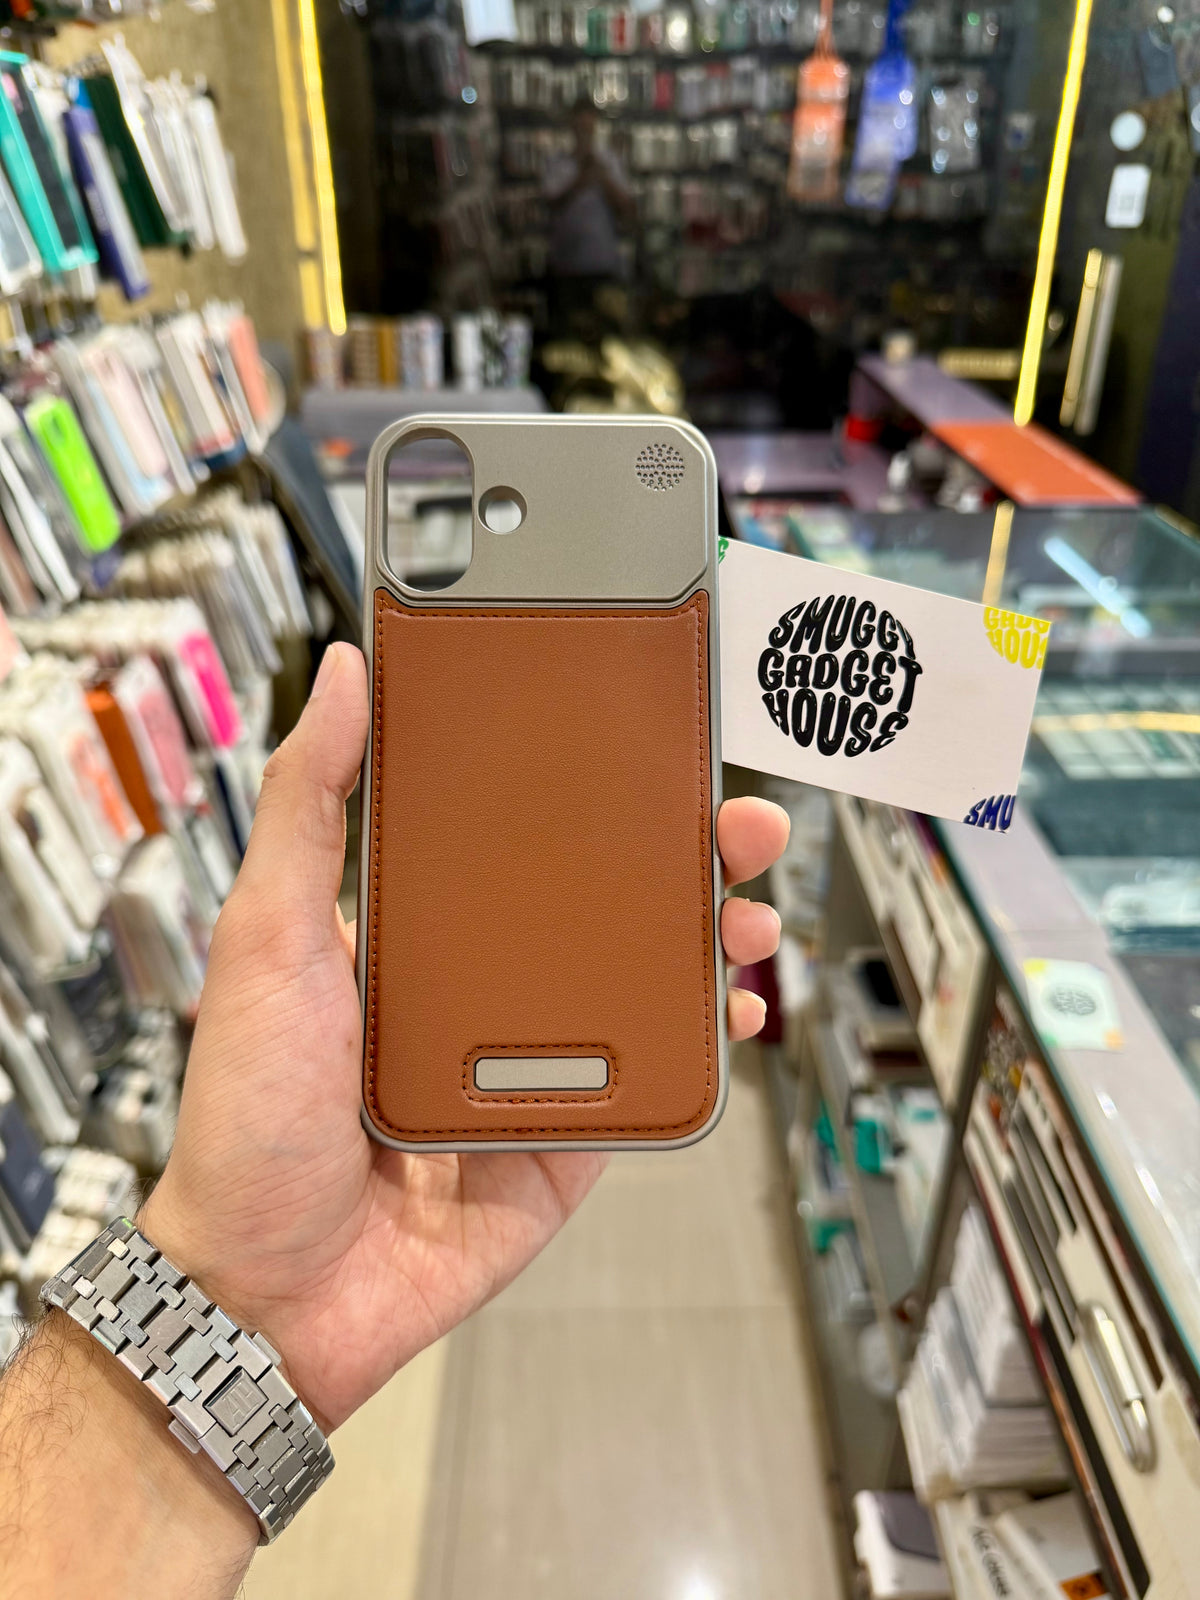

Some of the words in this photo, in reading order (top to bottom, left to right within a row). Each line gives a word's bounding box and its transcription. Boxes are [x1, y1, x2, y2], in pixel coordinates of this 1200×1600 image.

[768, 594, 916, 660] SMUGGY
[758, 647, 923, 714] GADGET
[761, 687, 909, 758] HOUSE
